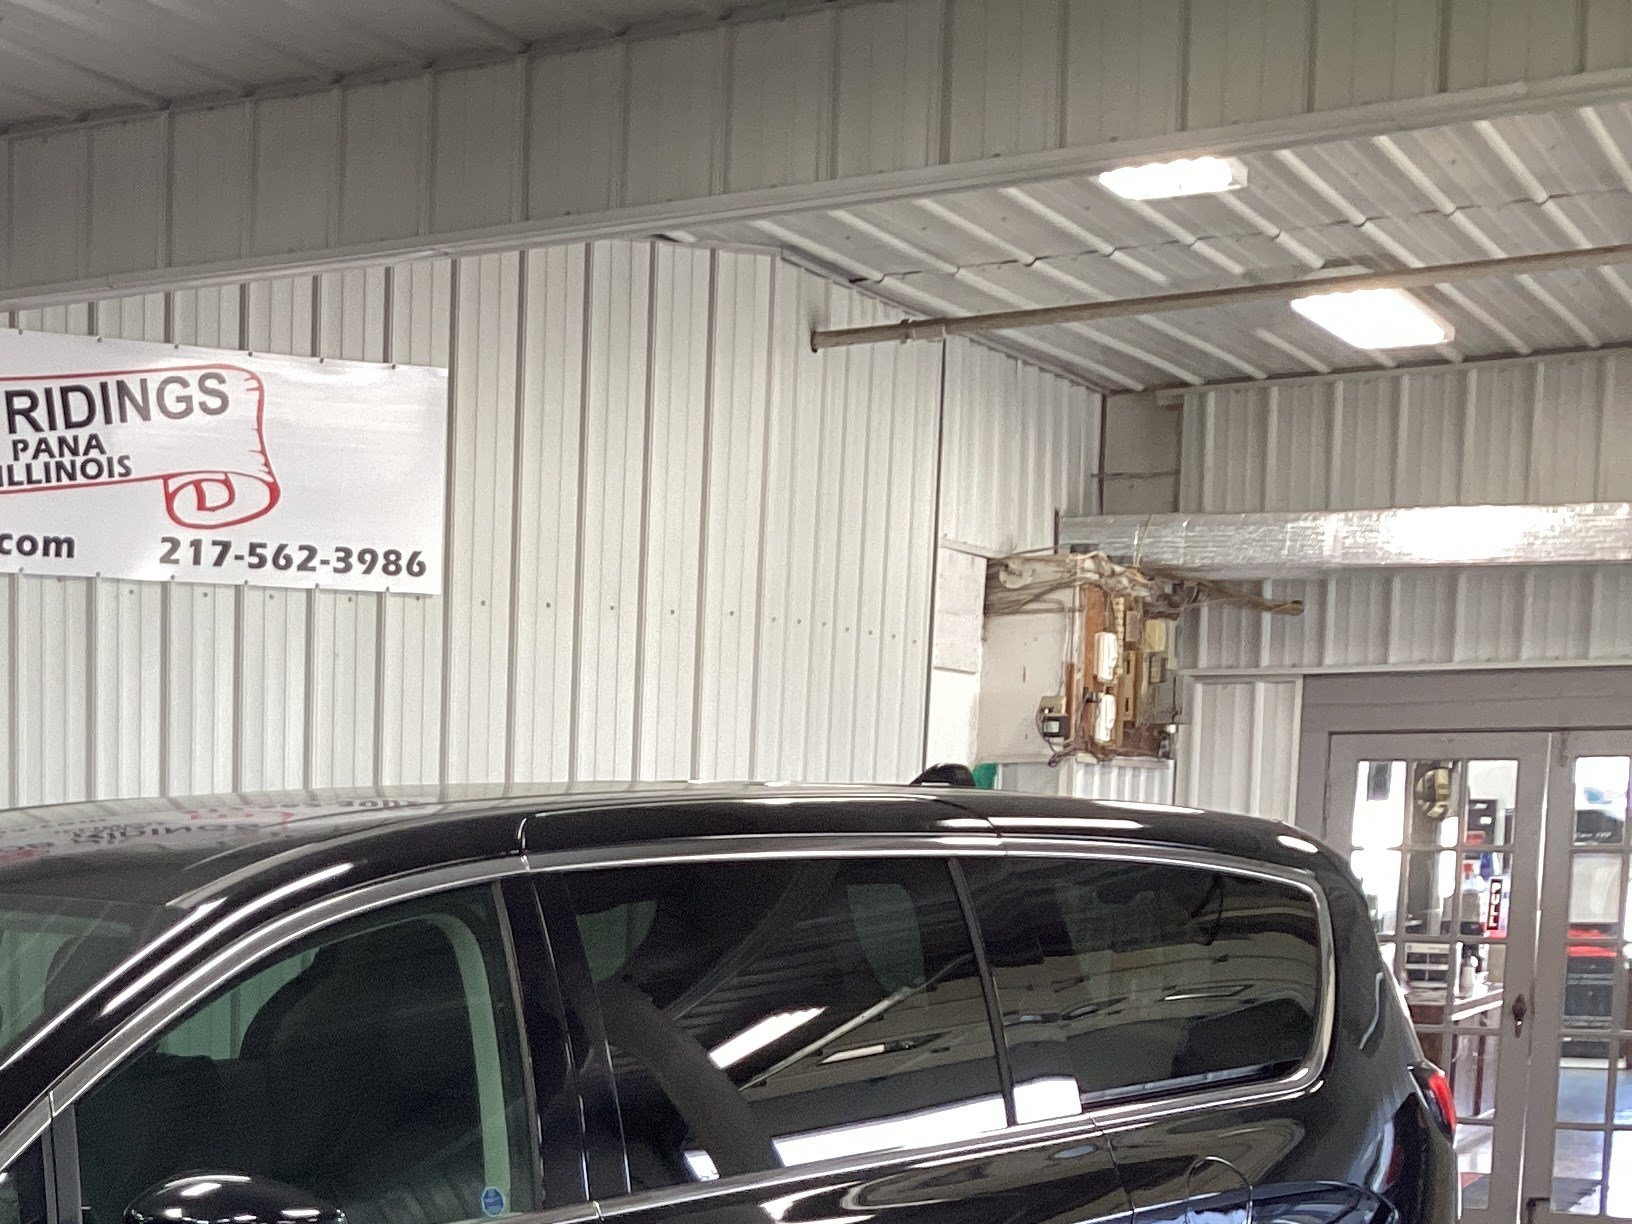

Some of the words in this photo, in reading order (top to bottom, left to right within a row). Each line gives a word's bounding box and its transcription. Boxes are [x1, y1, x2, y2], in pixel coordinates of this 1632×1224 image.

[6, 372, 230, 435] RIDINGS
[12, 433, 106, 462] PANA
[160, 537, 427, 578] 217-562-3986
[1488, 881, 1502, 929] PULL
